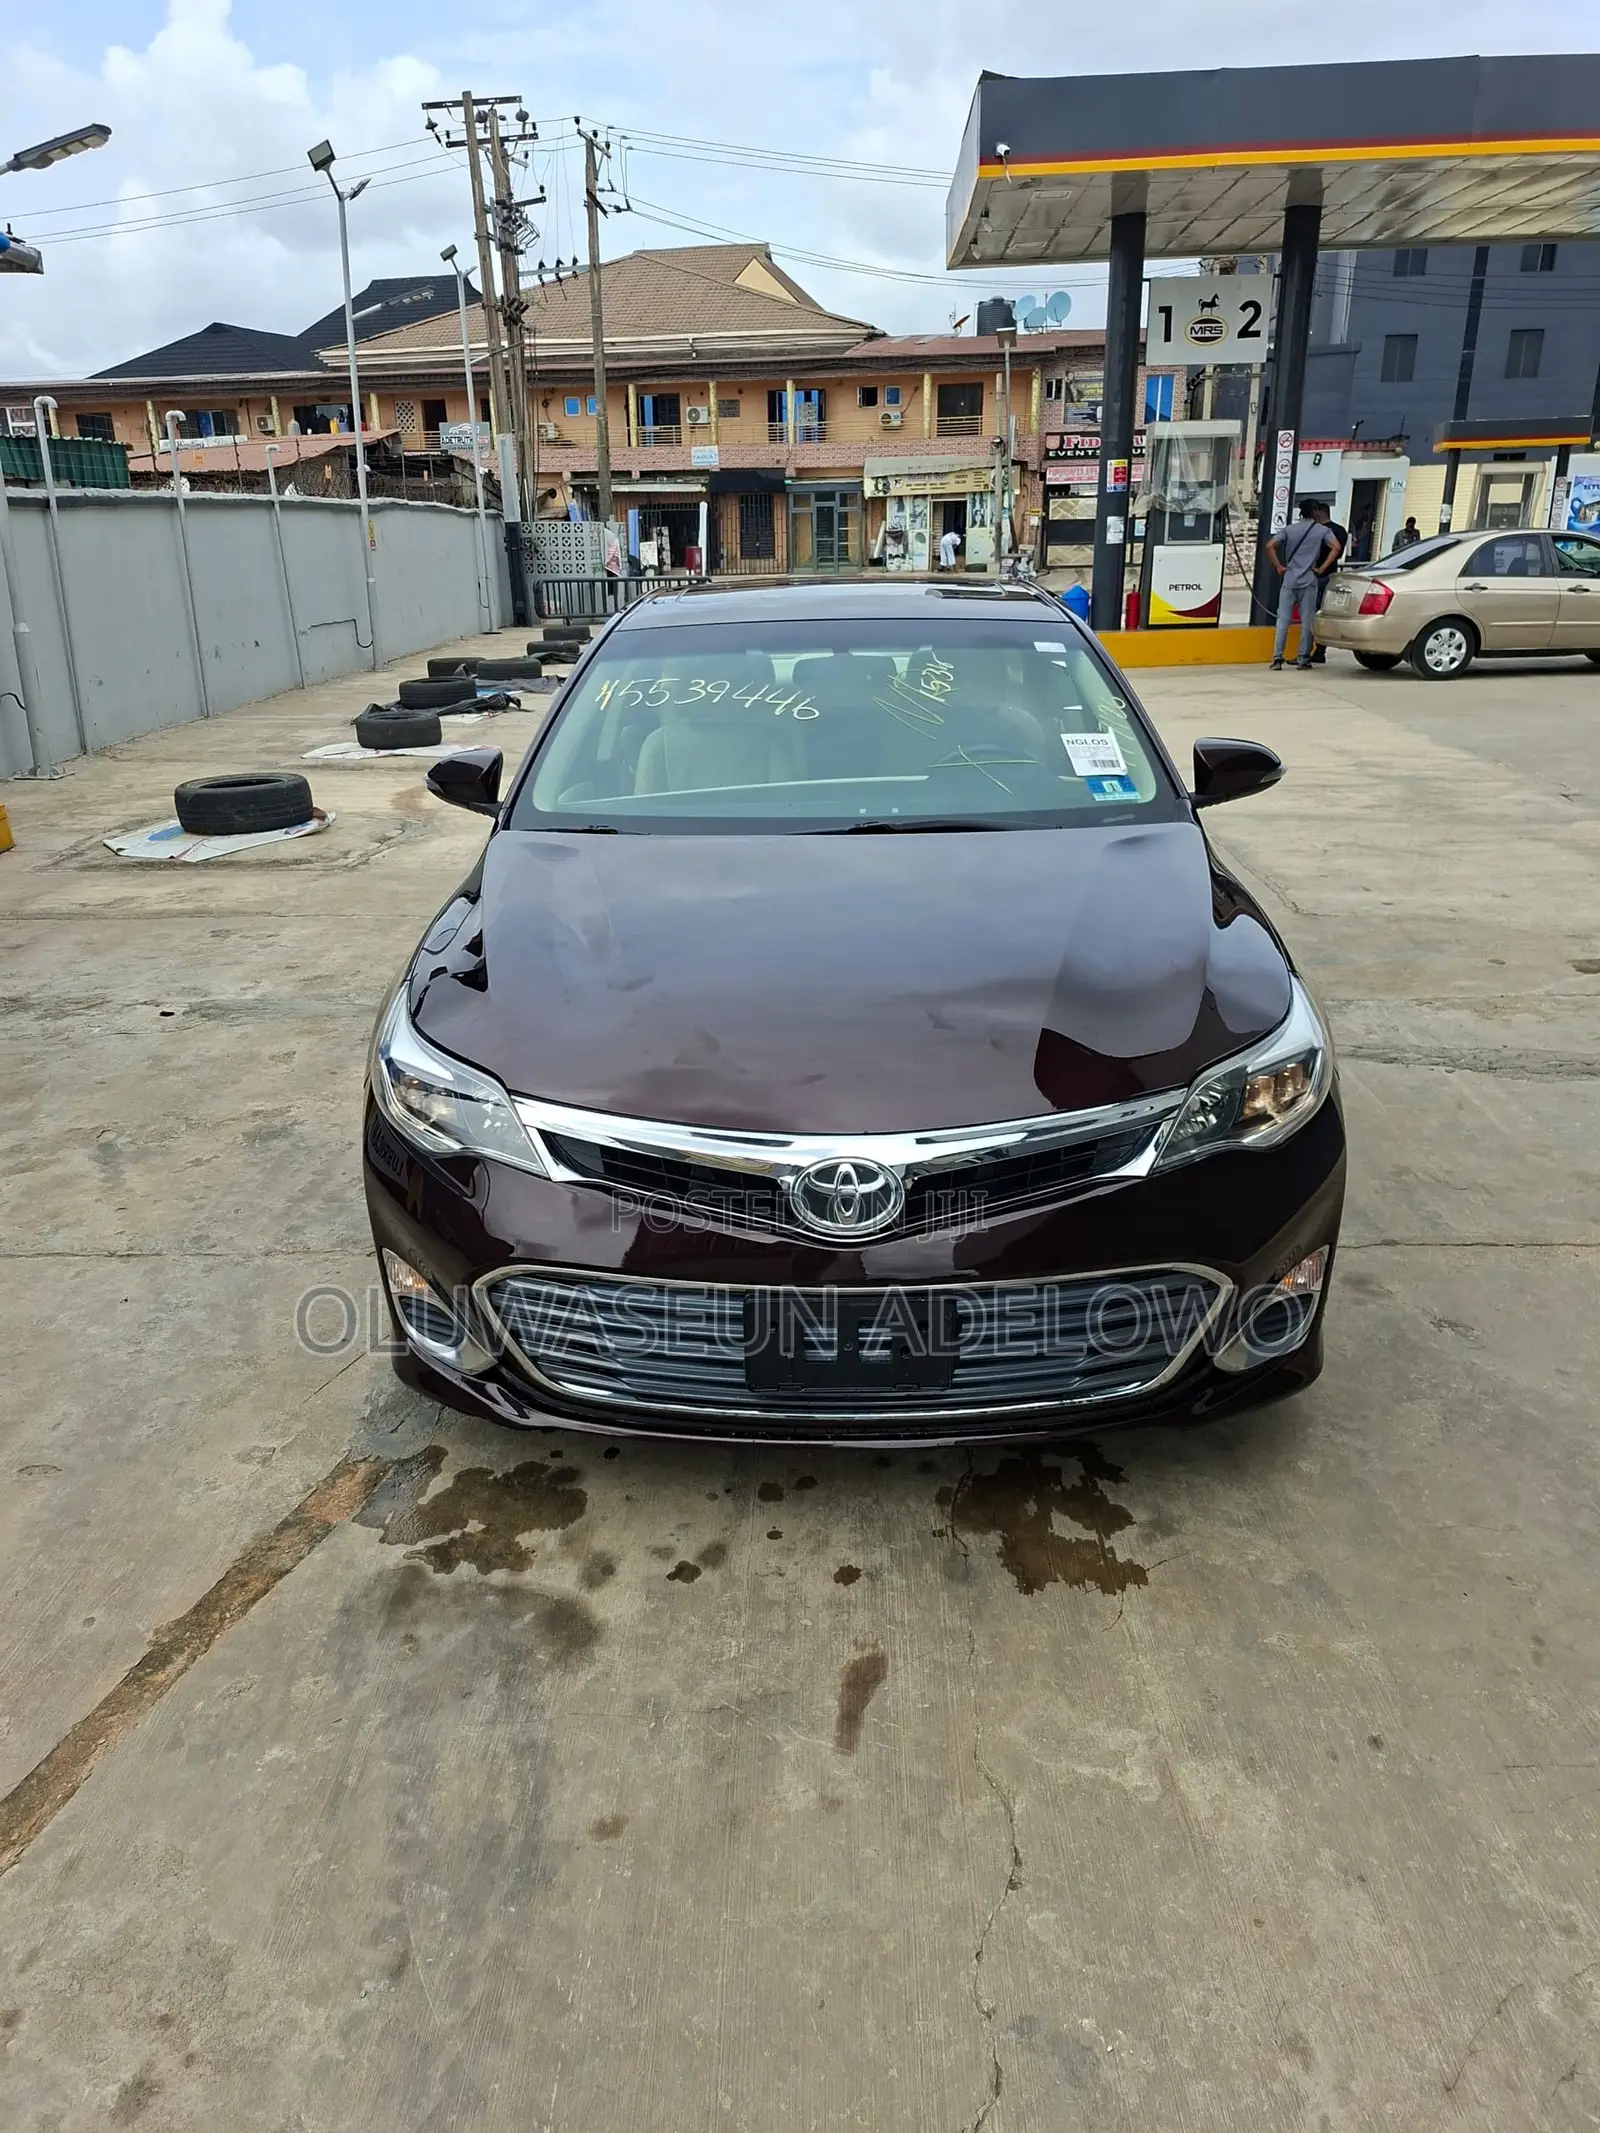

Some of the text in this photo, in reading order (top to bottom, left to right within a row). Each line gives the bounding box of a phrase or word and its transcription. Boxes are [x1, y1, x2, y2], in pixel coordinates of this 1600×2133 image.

[1158, 305, 1173, 343] 1
[1236, 299, 1263, 340] 2
[1189, 325, 1224, 336] MRS
[1168, 583, 1204, 592] PETROL
[1065, 738, 1109, 746] NGLOS
